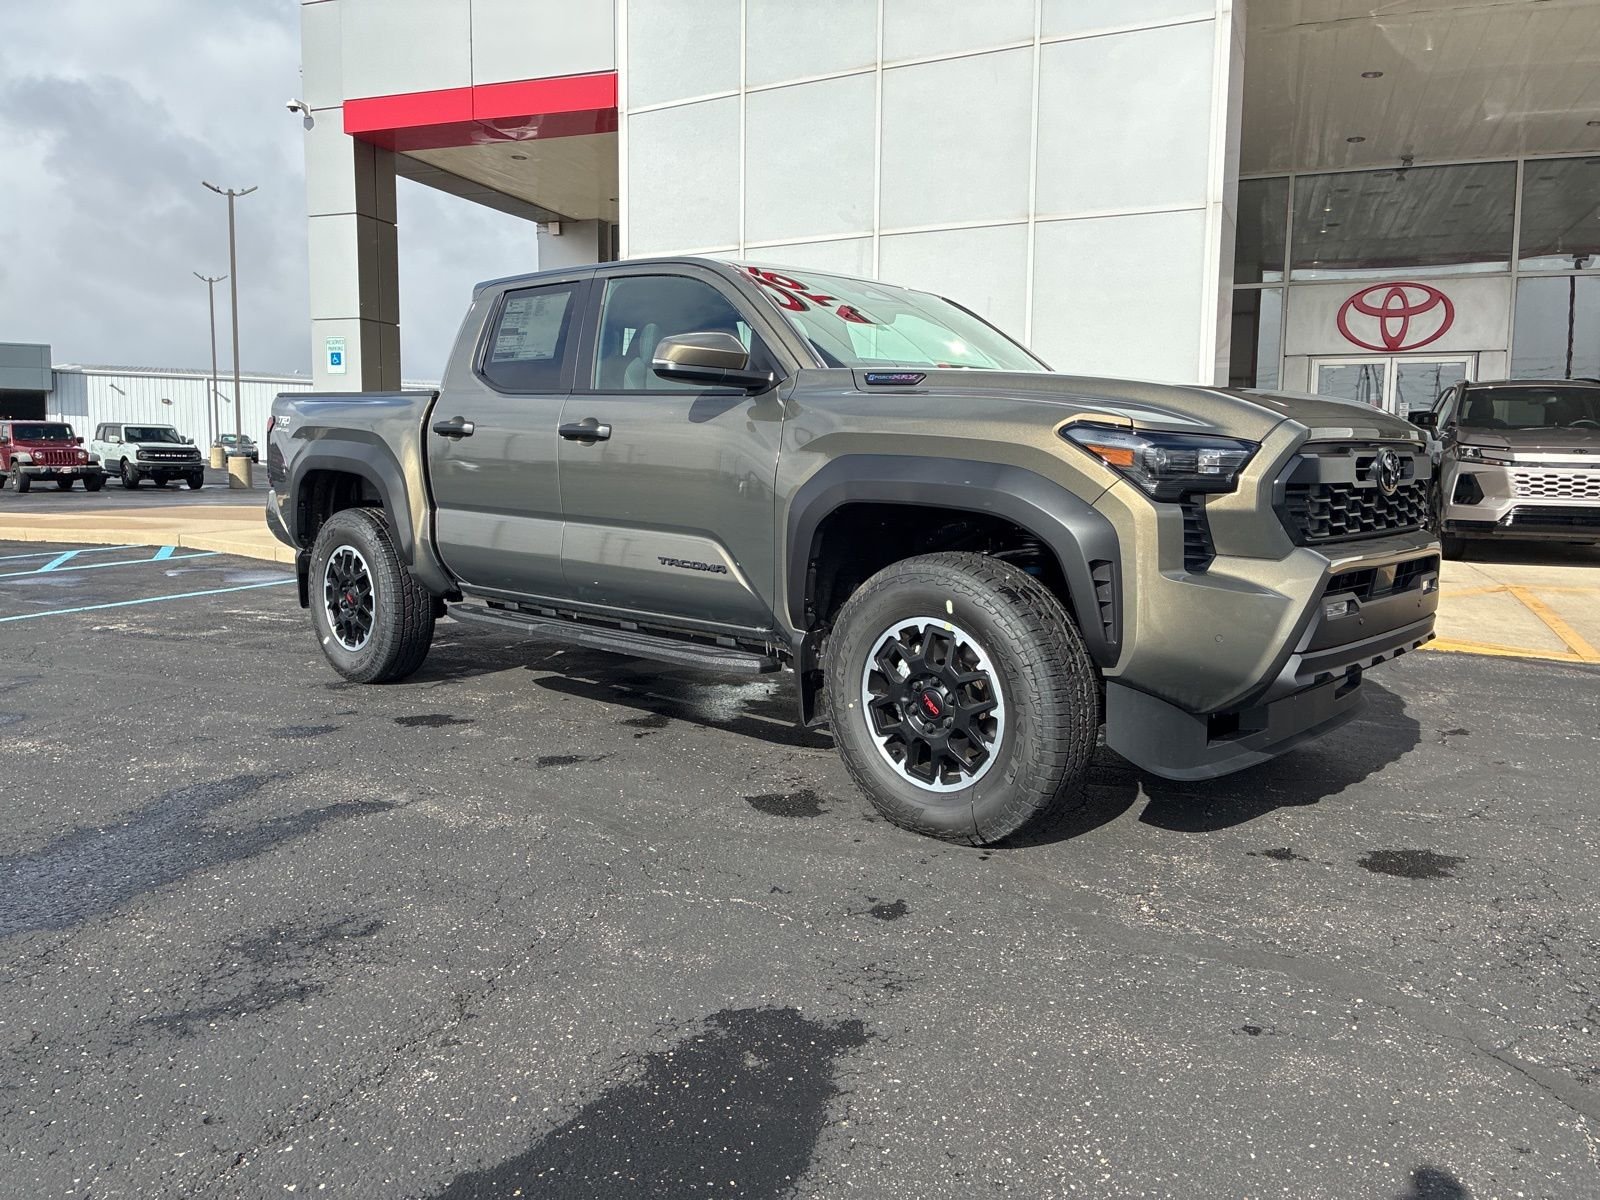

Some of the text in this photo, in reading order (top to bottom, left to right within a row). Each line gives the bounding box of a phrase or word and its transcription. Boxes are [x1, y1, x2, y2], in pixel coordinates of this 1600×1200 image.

[278, 415, 291, 426] TRD
[657, 556, 727, 574] TACOMA
[923, 694, 939, 715] TRD
